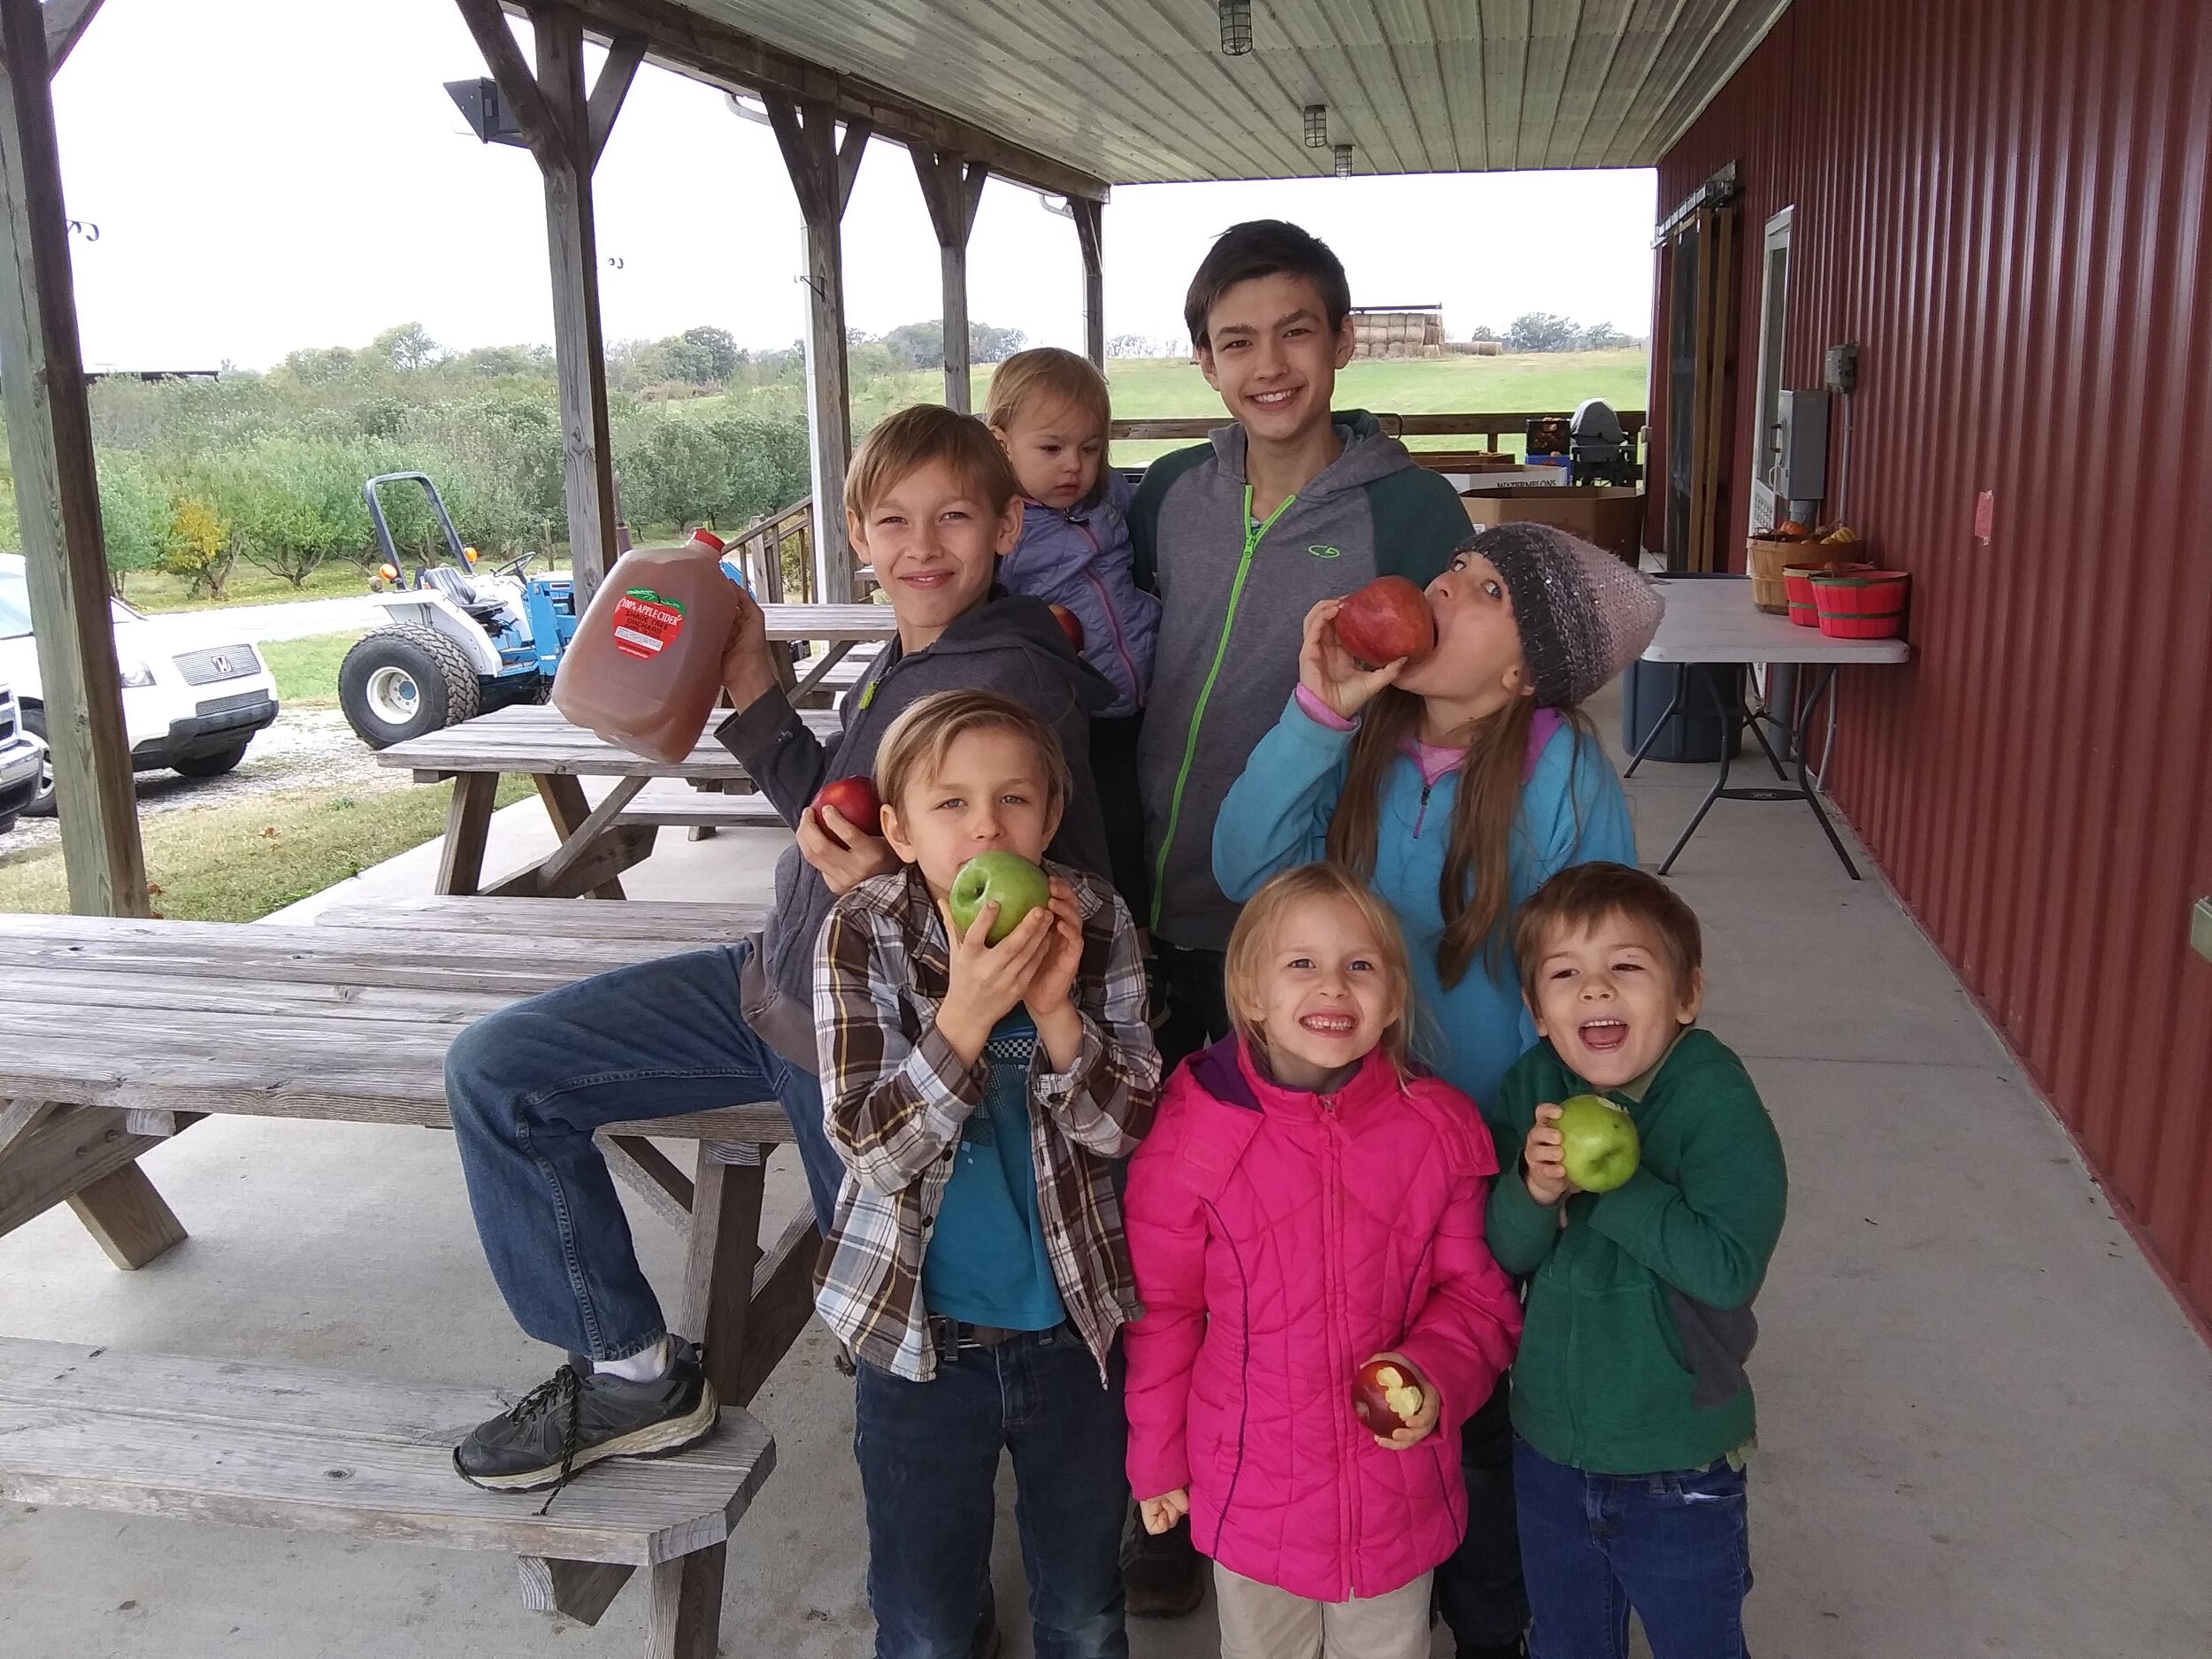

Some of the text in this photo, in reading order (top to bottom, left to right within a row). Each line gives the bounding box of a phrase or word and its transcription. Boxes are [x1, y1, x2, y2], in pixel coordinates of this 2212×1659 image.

[621, 598, 679, 626] 100% APPLE CIDER
[625, 610, 649, 623] SHADE
[651, 618, 669, 631] TREE
[626, 618, 663, 634] ORCHARD
